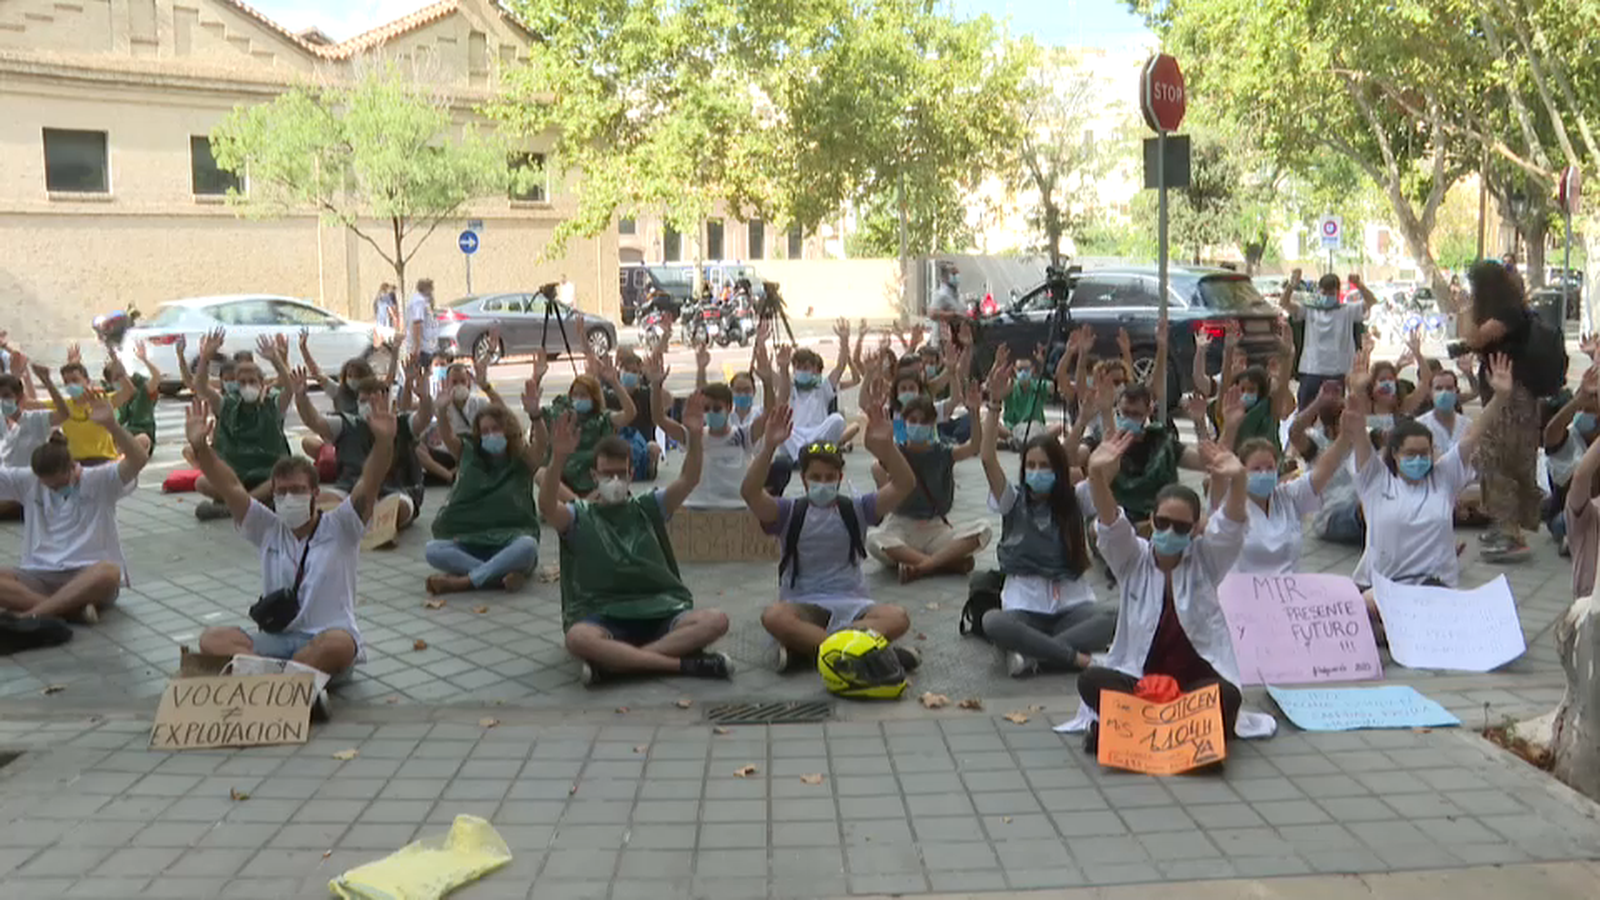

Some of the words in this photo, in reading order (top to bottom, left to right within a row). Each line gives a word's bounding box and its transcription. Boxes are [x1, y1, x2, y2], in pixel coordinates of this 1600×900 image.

[1154, 81, 1182, 104] STOP
[1252, 576, 1307, 604] MIR
[1284, 601, 1358, 622] PRESENTE
[1291, 620, 1359, 642] FUTURO
[173, 678, 313, 708] VOCACIÓN
[1141, 689, 1218, 722] COTICEN
[151, 718, 302, 746] EXPLOTACIÓN
